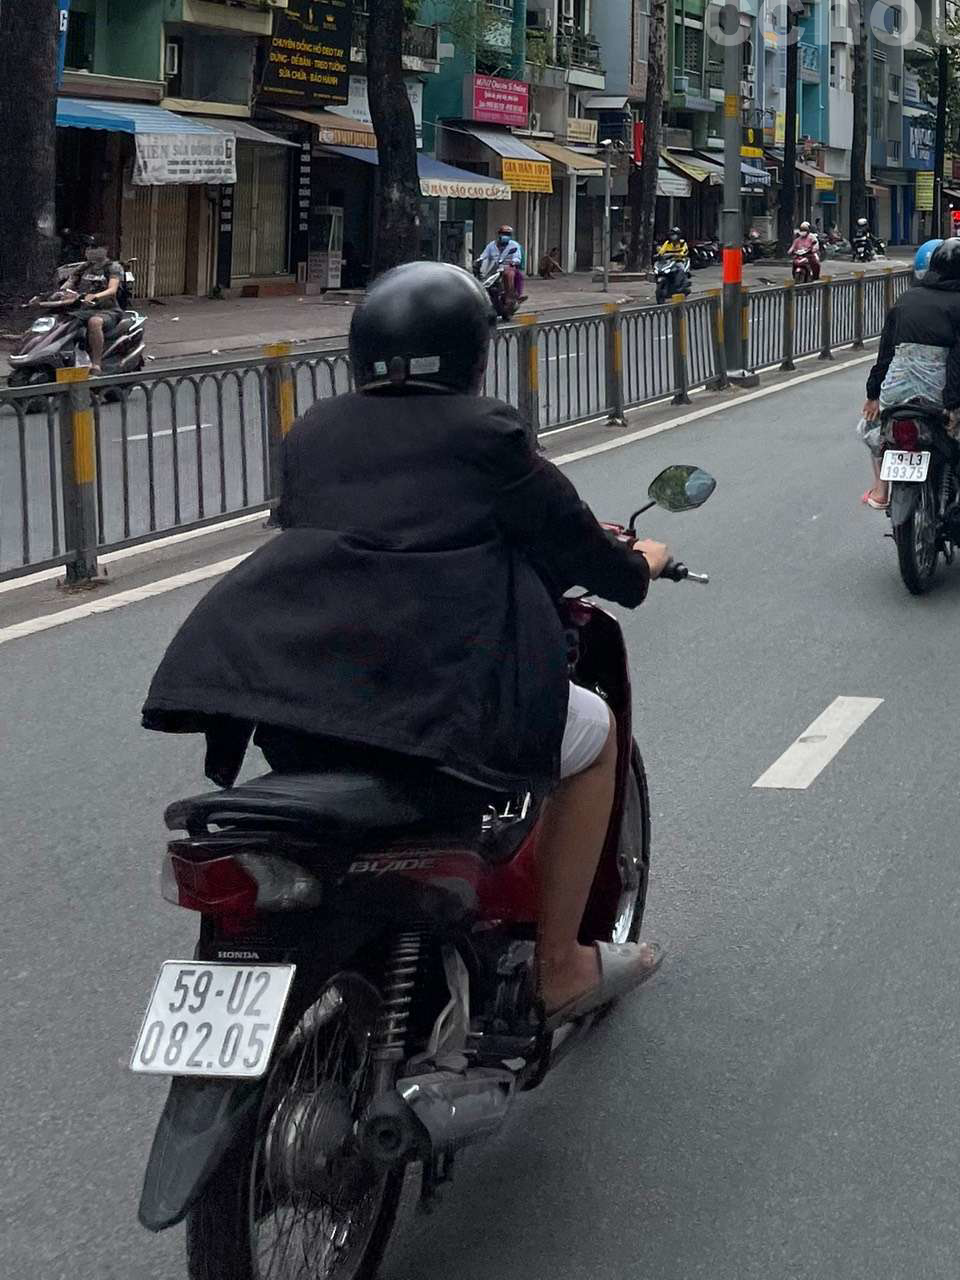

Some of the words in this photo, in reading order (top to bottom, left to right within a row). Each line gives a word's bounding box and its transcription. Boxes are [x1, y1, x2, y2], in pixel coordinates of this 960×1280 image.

[887, 465, 924, 480] 193.75
[348, 859, 435, 878] BLADE
[217, 951, 260, 960] HONDA
[168, 970, 271, 1017] 59-U2
[140, 1020, 270, 1069] 082.05
